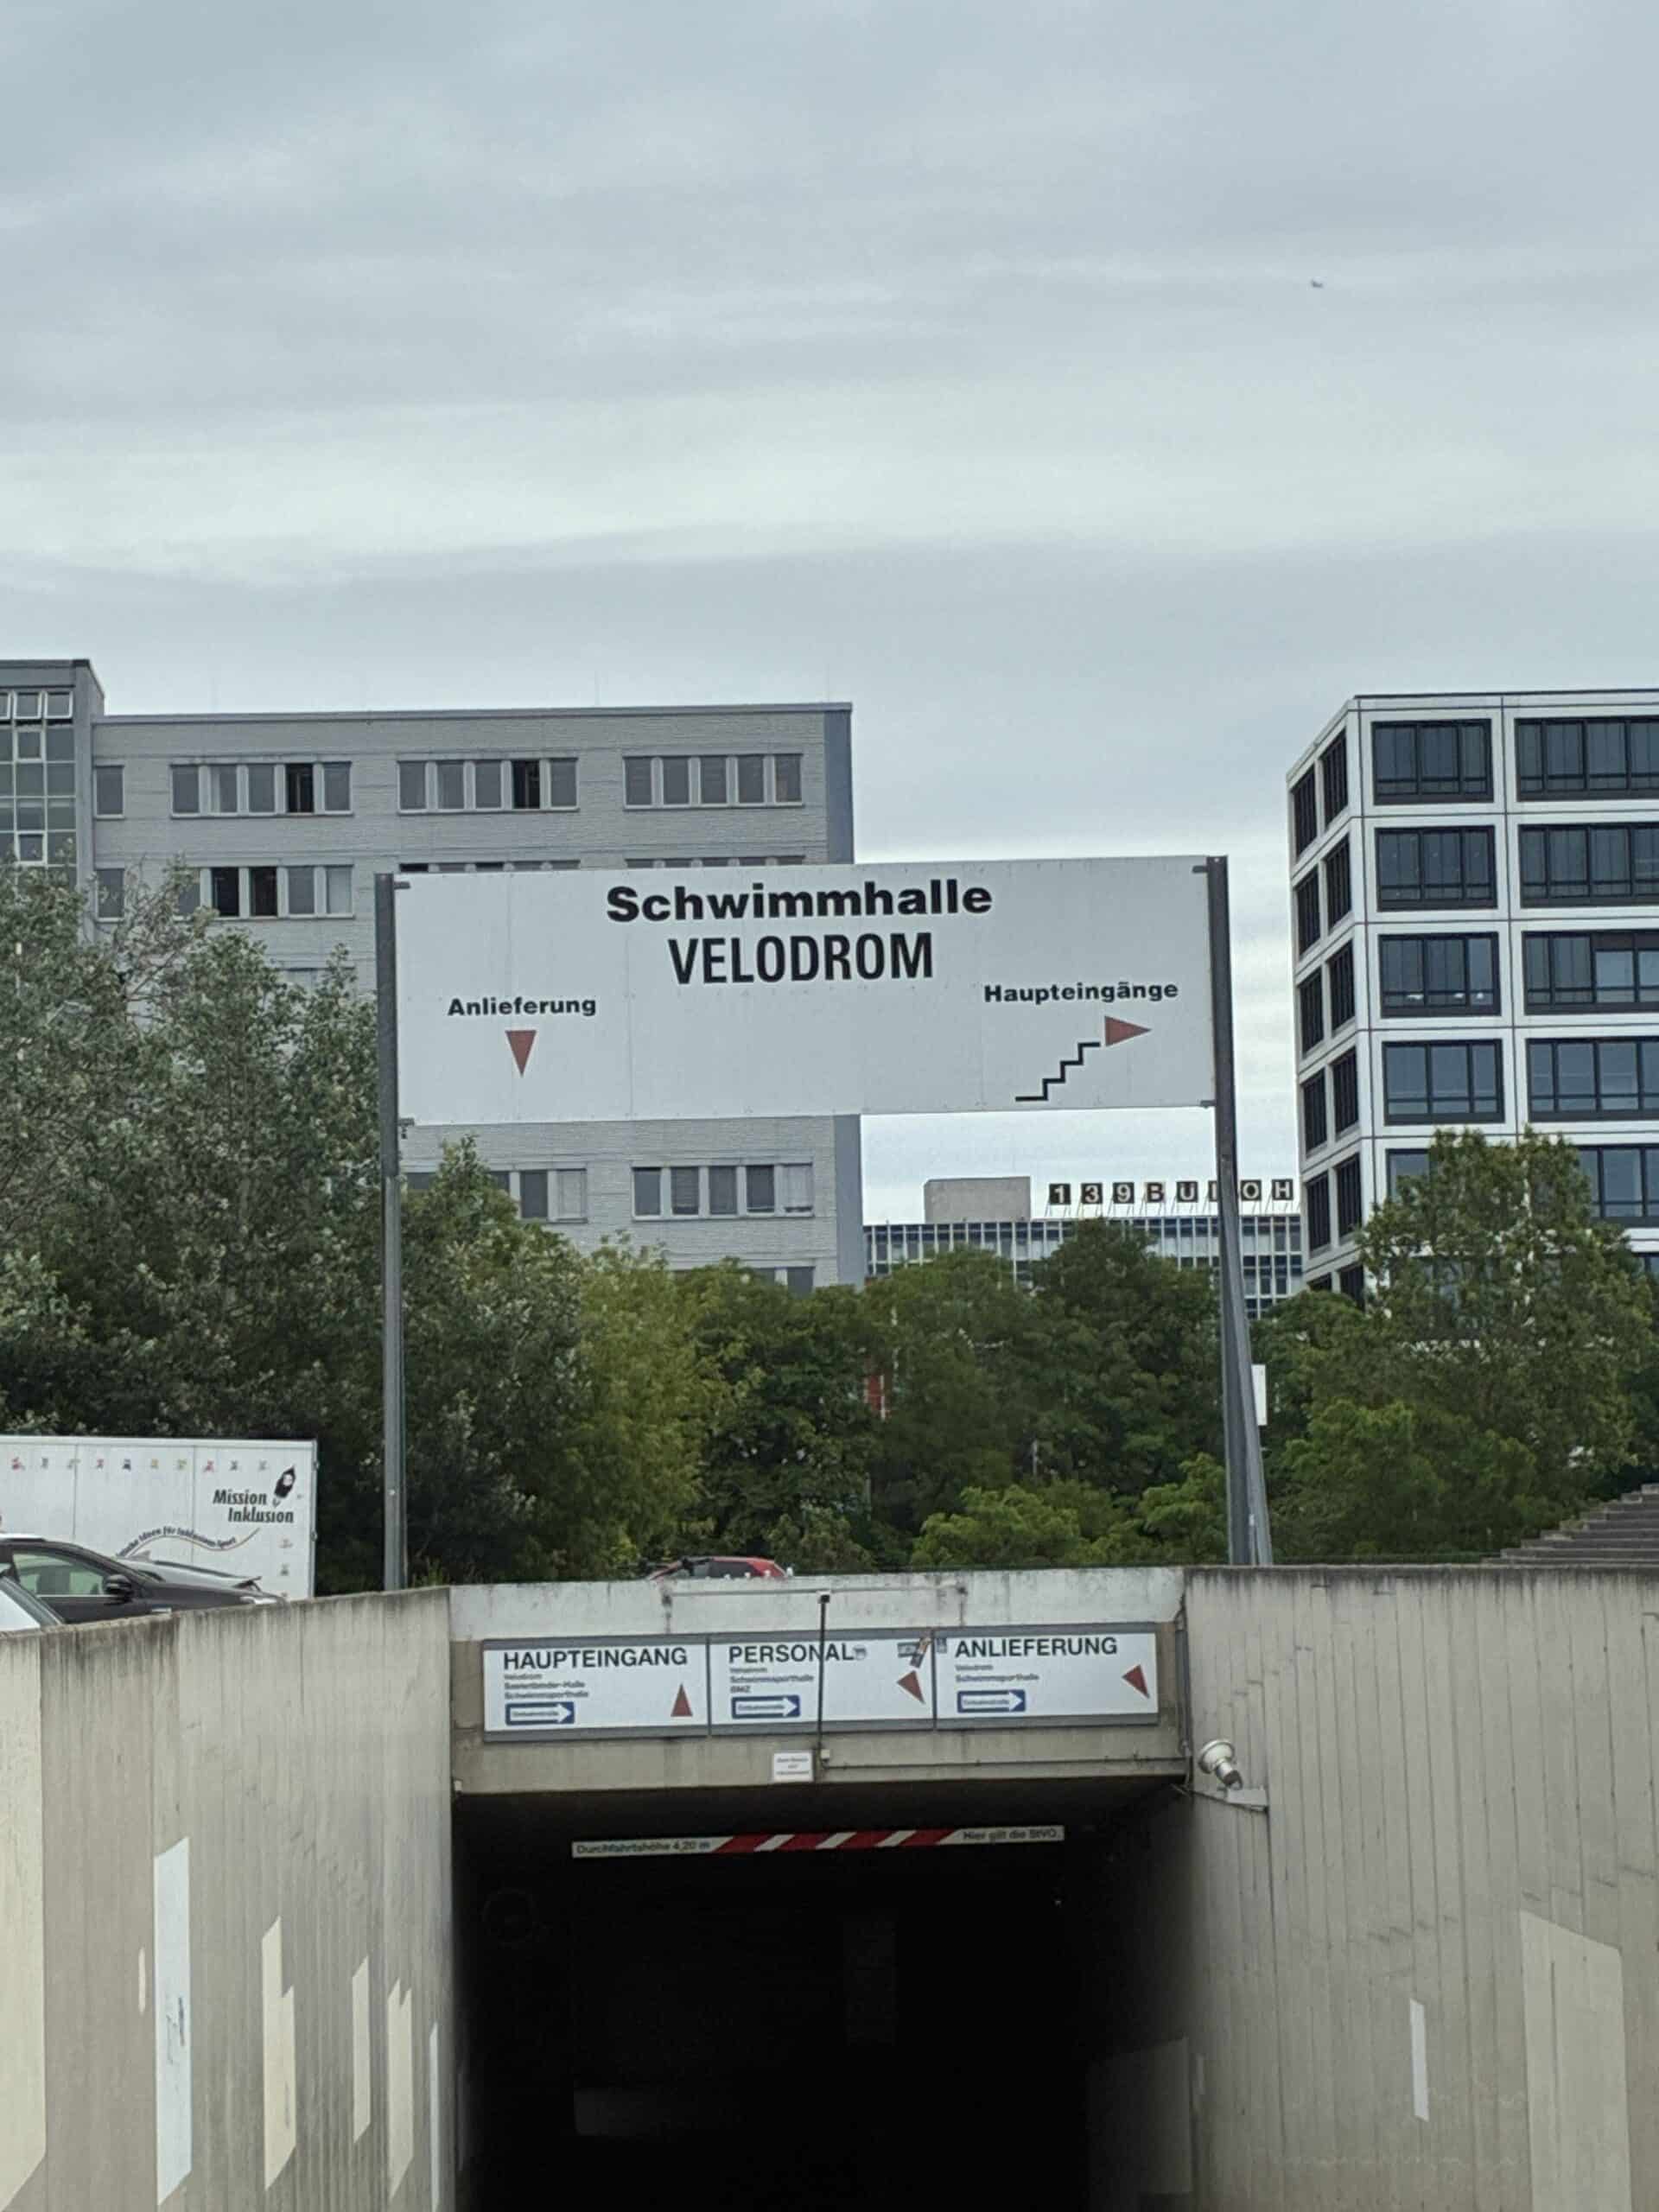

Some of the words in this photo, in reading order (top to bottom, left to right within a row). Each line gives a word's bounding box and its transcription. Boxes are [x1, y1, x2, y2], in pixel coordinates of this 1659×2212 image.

[607, 880, 993, 922] Schwimmhalle
[668, 932, 934, 985] VELODROM
[984, 981, 1179, 1005] Haupteingänge
[448, 996, 596, 1019] Anlieferung
[213, 1489, 268, 1506] Mission
[227, 1507, 295, 1524] Inklusion
[504, 1647, 688, 1669] HAUPTEINGANG
[728, 1643, 855, 1663] PERSONAL
[955, 1637, 1118, 1658] ANLIEFERUNG
